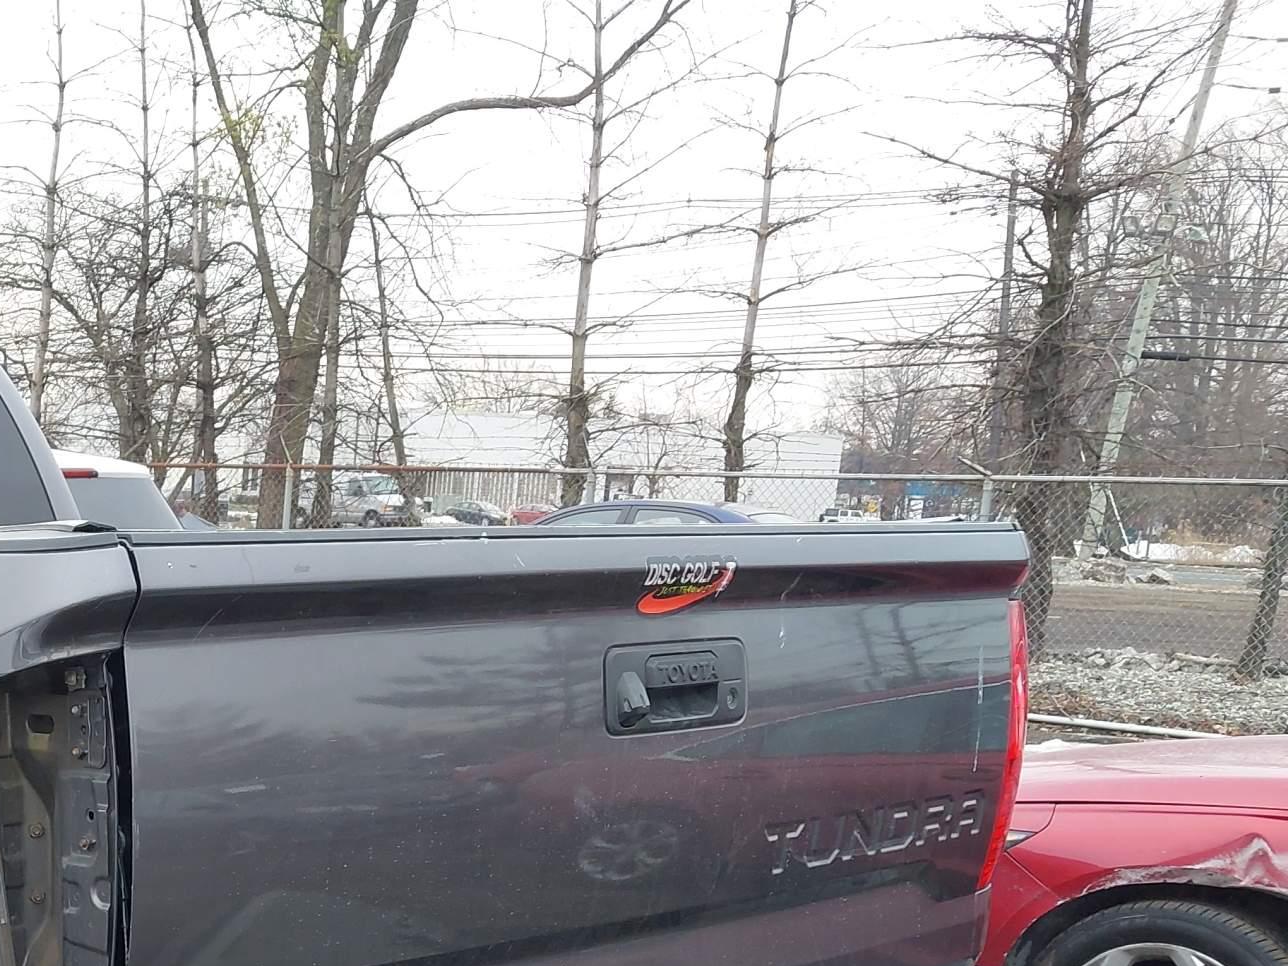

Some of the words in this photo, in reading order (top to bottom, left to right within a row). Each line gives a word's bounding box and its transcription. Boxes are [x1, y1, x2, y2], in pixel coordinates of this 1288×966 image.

[644, 562, 681, 586] DISC
[681, 561, 720, 584] GOLF
[656, 661, 719, 684] TOYOTA
[764, 789, 985, 875] TUNDRA
